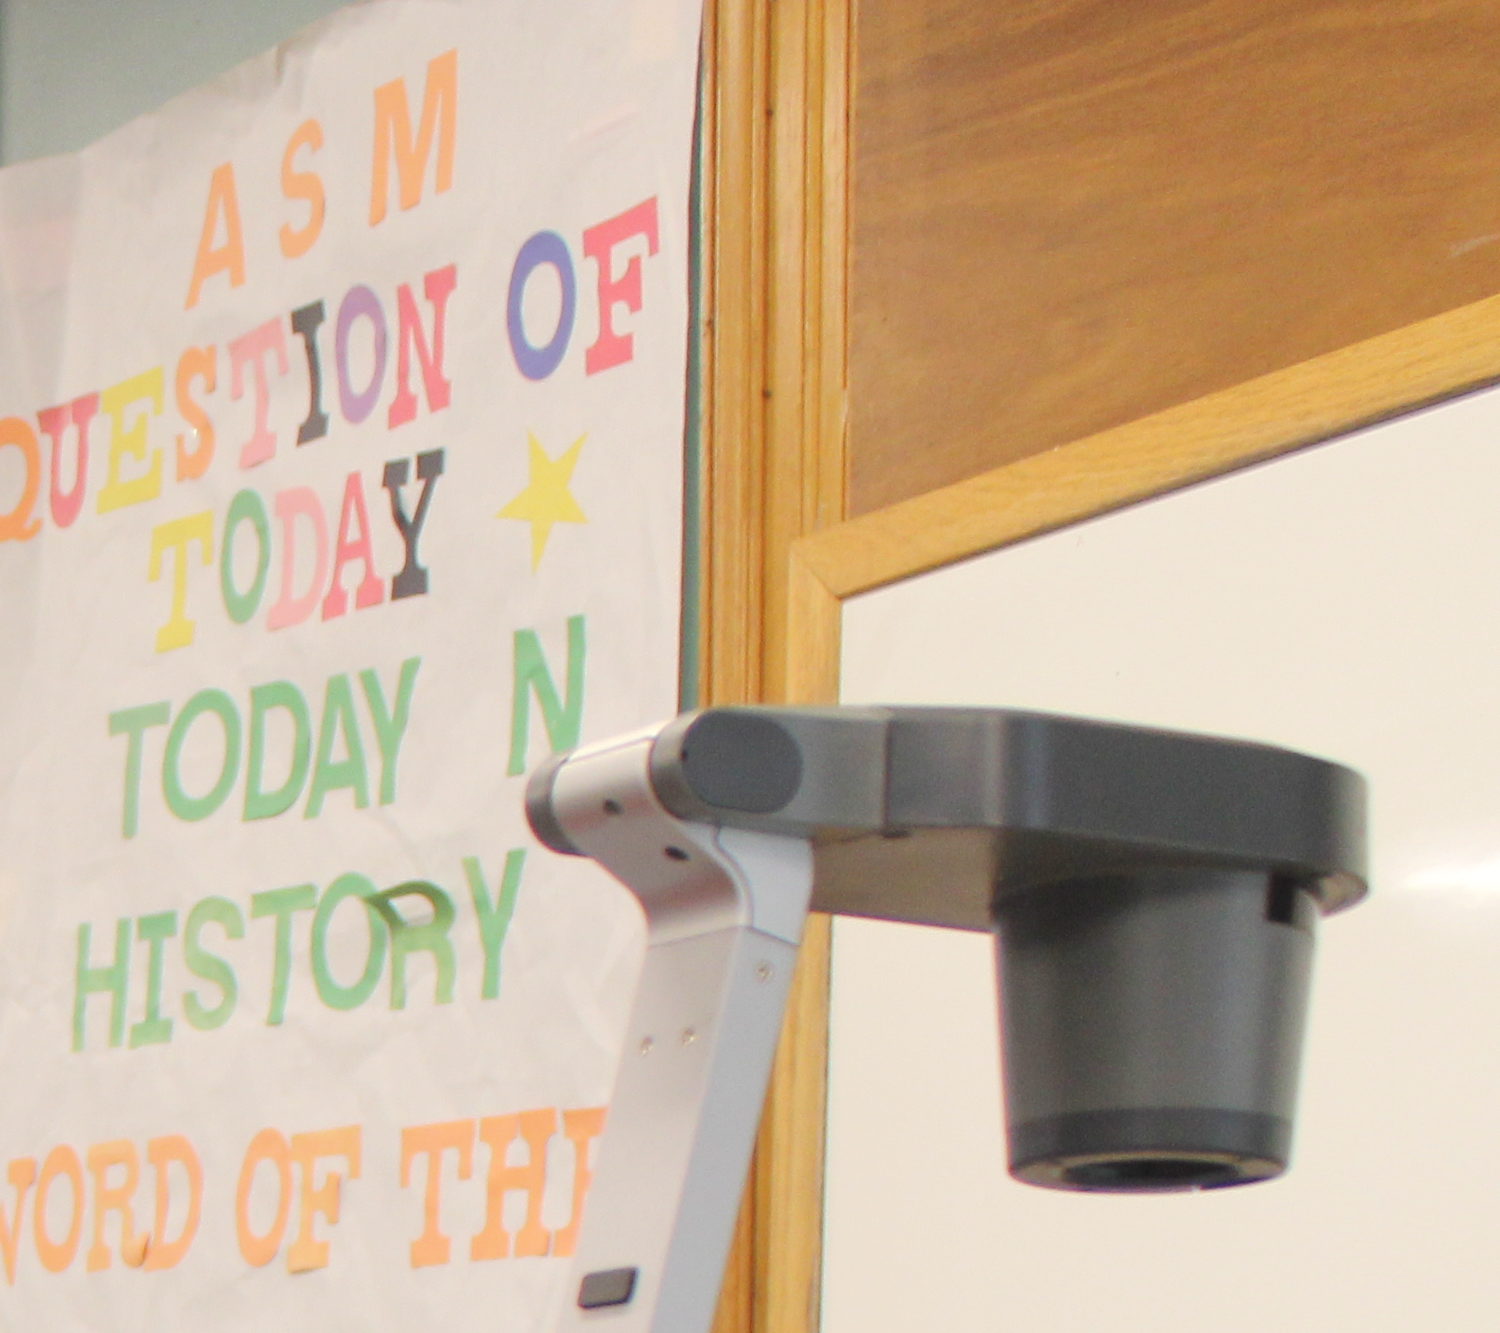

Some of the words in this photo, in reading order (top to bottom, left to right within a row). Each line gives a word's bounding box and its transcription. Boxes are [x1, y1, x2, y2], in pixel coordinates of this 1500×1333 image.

[506, 194, 660, 383] OF
[148, 447, 446, 655] TODAY
[107, 656, 422, 840] TODAY
[507, 614, 587, 777] N
[71, 848, 527, 1053] HISTORY
[235, 1124, 362, 1275] OF
